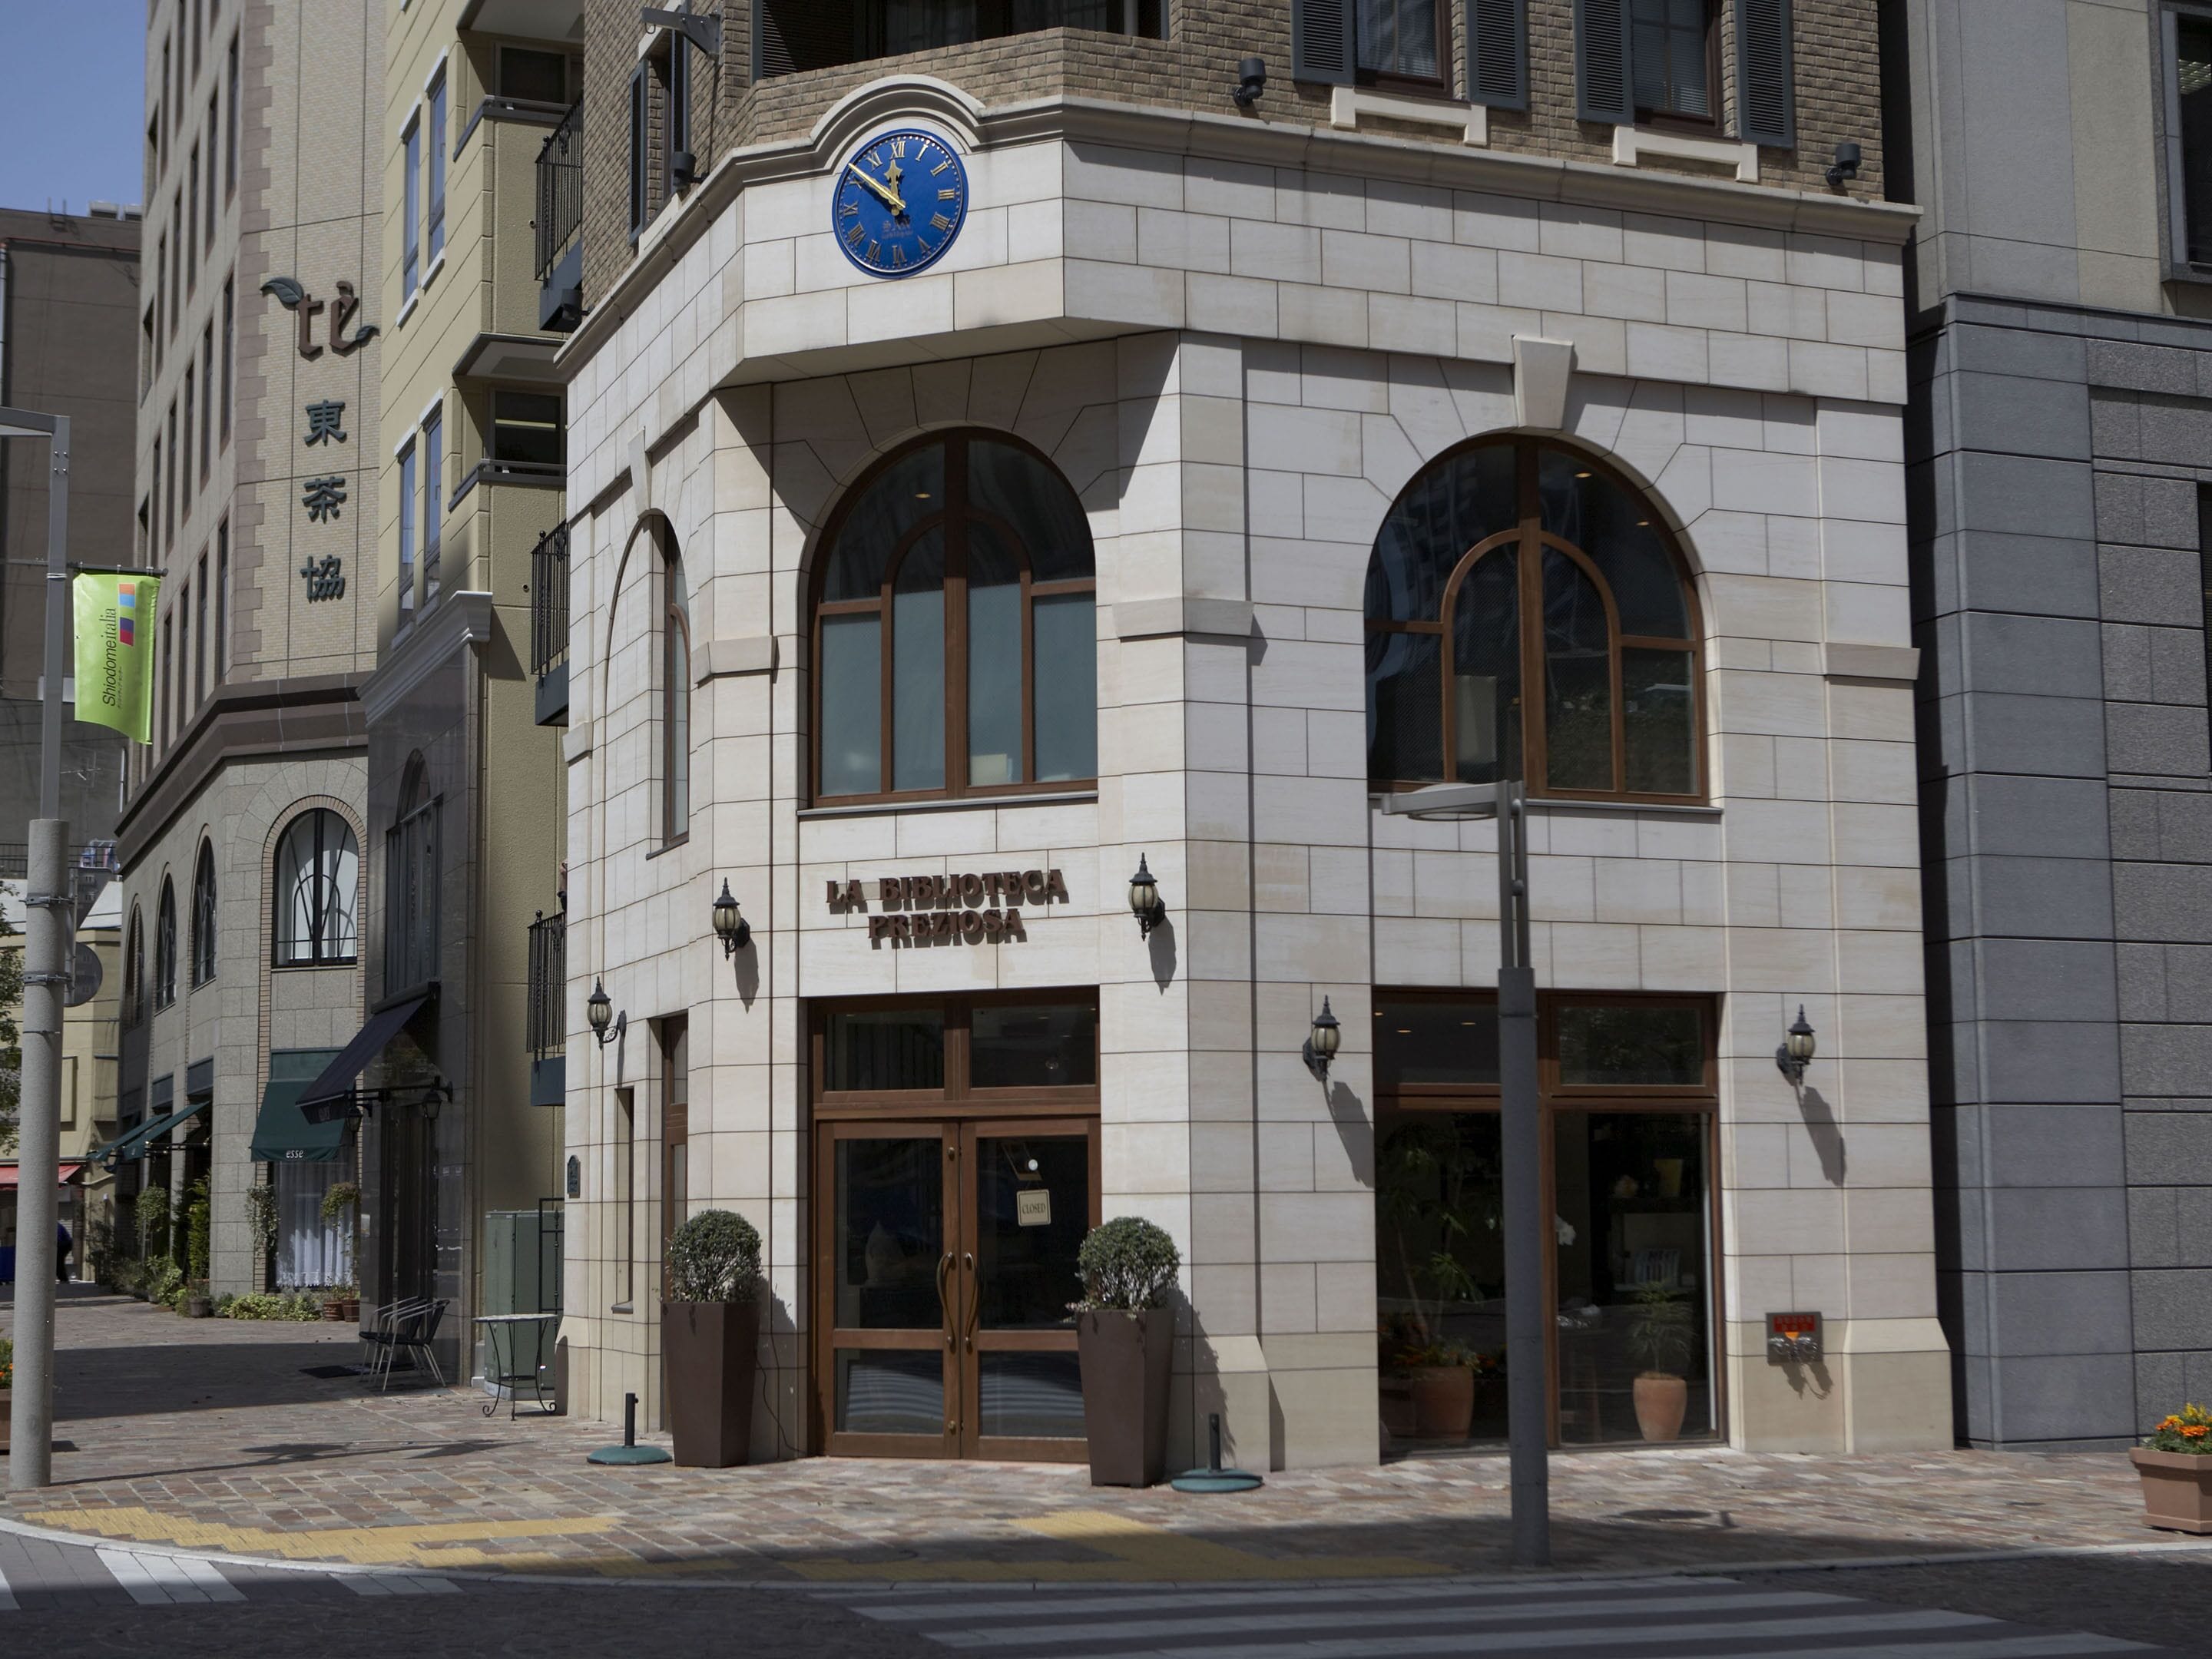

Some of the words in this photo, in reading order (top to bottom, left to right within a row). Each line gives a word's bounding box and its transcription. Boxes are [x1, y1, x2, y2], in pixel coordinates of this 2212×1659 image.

[891, 141, 906, 159] XII
[866, 152, 882, 170] XI
[931, 162, 949, 177] II
[938, 189, 955, 201] III
[892, 245, 906, 265] VI
[300, 399, 347, 604] 東茶協
[826, 879, 866, 909] LA
[879, 869, 1068, 906] BIBLIOTECA
[867, 908, 1025, 944] PREZIOSA
[286, 1150, 304, 1158] esse
[1022, 1204, 1046, 1214] CLOSED
